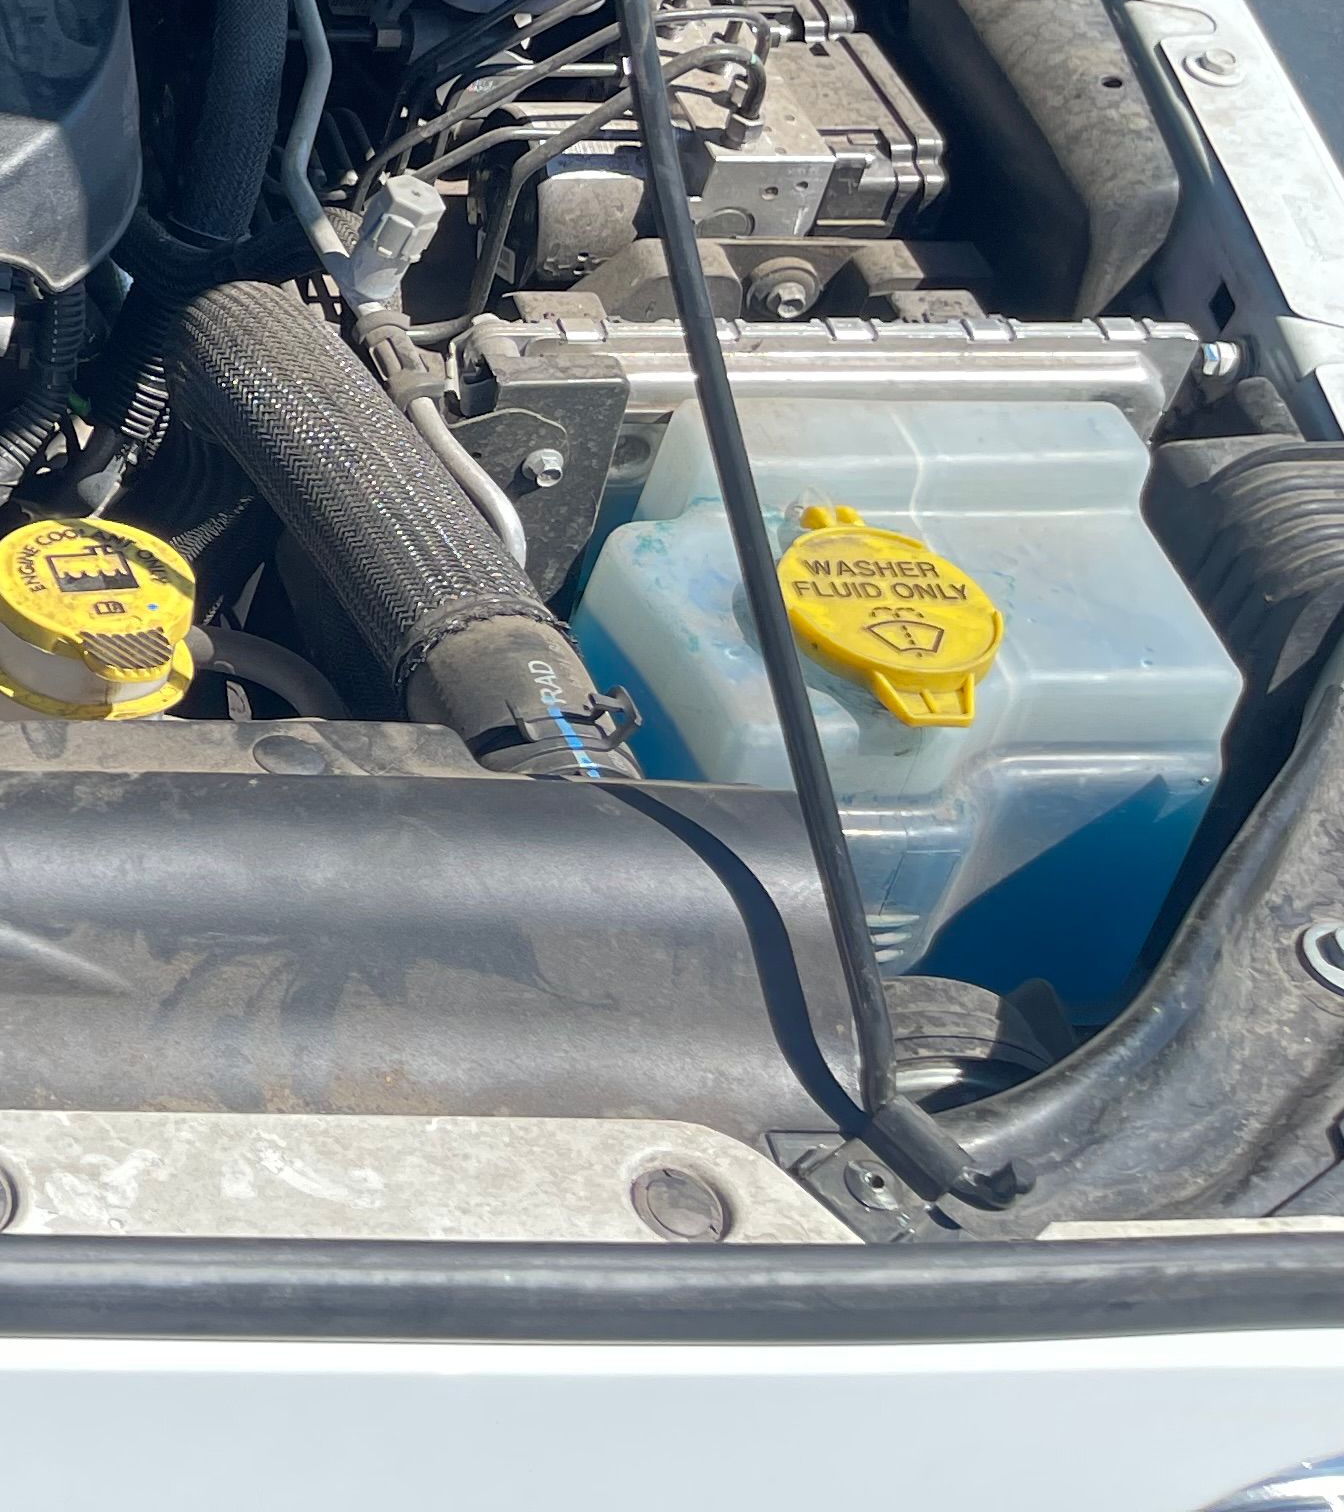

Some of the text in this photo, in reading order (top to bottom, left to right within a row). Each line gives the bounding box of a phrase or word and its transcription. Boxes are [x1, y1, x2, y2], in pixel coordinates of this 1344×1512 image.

[16, 543, 47, 593] ENGINE
[35, 527, 136, 548] COOLANT
[803, 559, 940, 579] WASHER
[791, 580, 968, 601] FLUID ONLY
[527, 659, 566, 704] RAD
